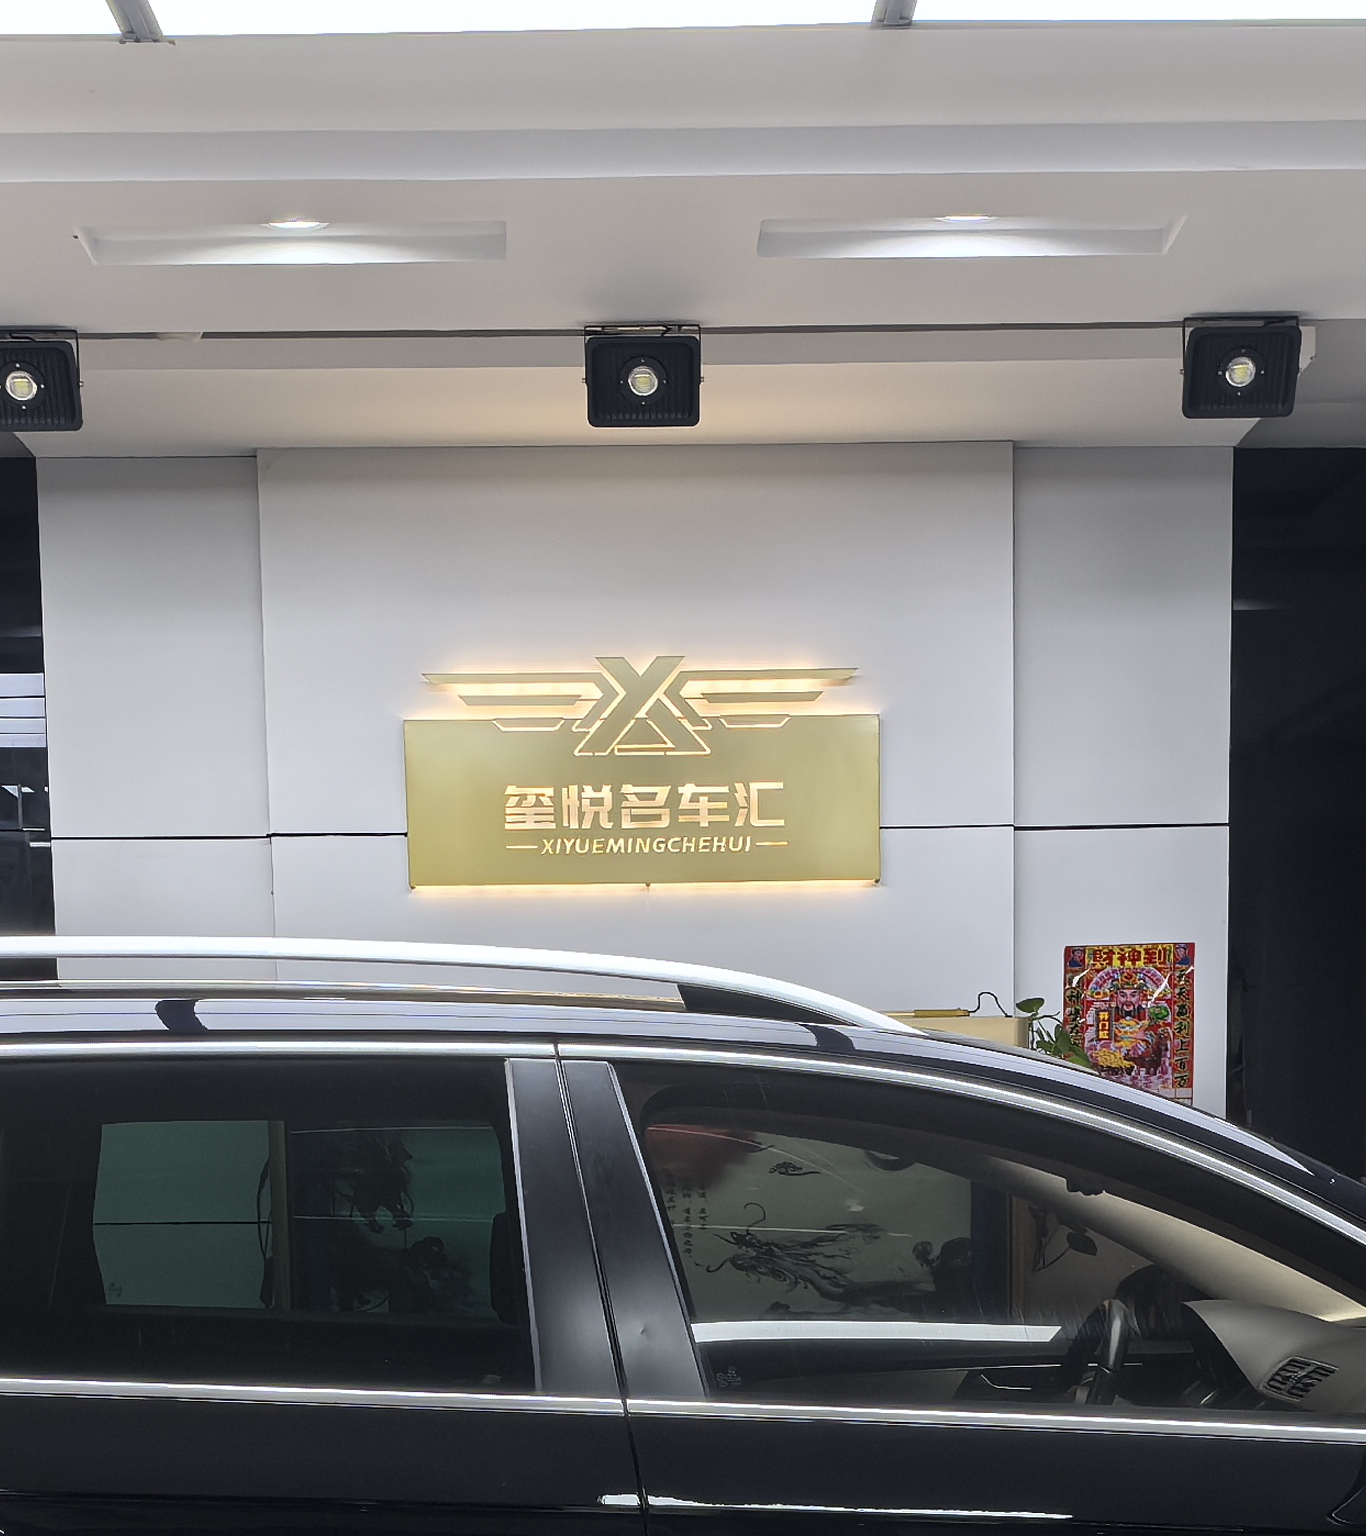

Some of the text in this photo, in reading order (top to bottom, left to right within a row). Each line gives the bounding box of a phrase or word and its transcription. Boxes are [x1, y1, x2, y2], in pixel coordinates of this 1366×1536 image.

[503, 780, 786, 830] 玺悦名车汇
[540, 835, 752, 856] XIYUEMINGCHEHUI
